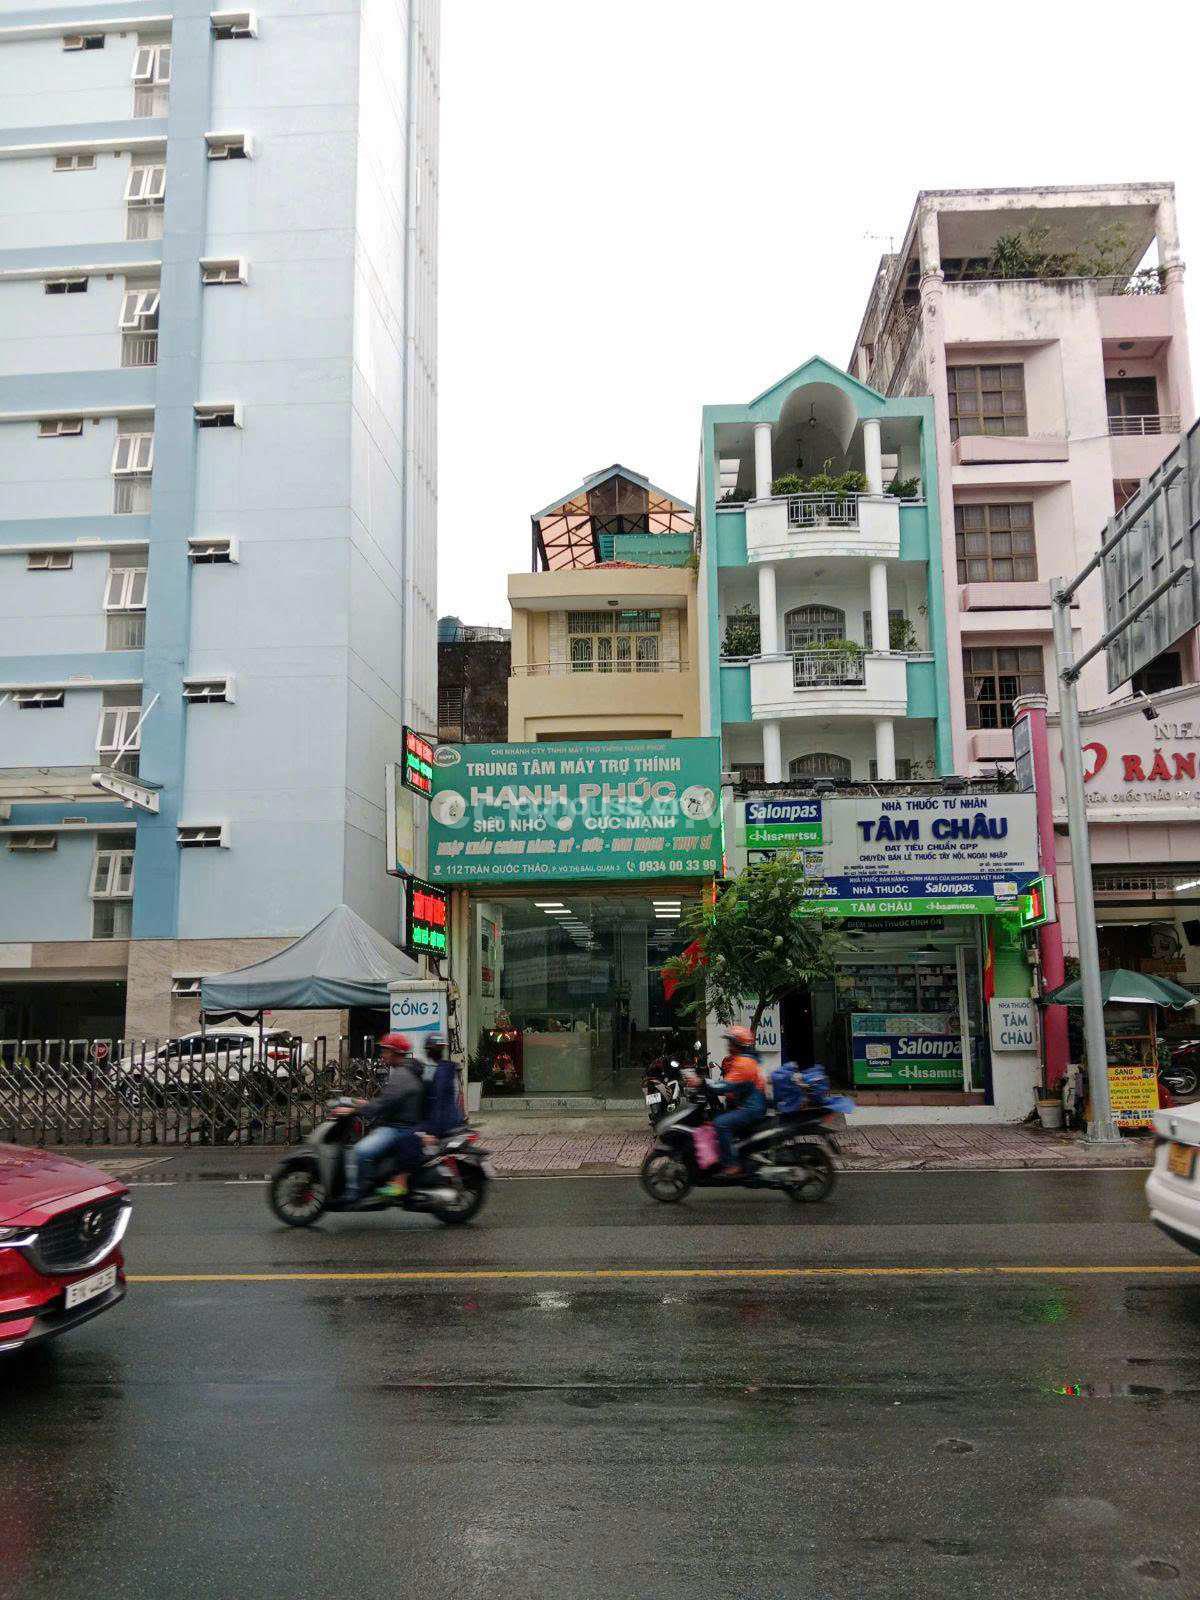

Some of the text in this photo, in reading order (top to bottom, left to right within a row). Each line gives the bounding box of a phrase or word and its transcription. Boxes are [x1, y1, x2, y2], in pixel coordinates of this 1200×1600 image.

[467, 756, 680, 776] TRUNG TÂM MÁY TRỢ THÍNH
[1121, 748, 1199, 781] RĂN
[470, 777, 677, 809] HẠNH PHÚC
[881, 797, 987, 811] NHÀ THUỐC TƯ NHÂN
[473, 814, 675, 833] SIÊU NHỎ CỰC MẠNH
[857, 813, 1008, 841] TÂM CHÂU
[904, 842, 924, 851] TIÊU
[927, 841, 957, 851] CHUẨN
[960, 843, 978, 851] GPP
[669, 860, 683, 871] 00
[685, 860, 700, 871] 33
[702, 859, 717, 870] 99
[859, 853, 886, 862] CHUYÊN
[914, 852, 937, 860] THUỐC
[446, 864, 464, 875] 112
[465, 863, 490, 874] TRẦN
[491, 863, 520, 874] QUỐC
[852, 884, 874, 895] NHÀ
[876, 884, 909, 895] THUỐC
[850, 901, 876, 913] TÂM
[879, 900, 913, 912] CHÂU
[391, 997, 439, 1016] CỔNG 2
[1003, 1011, 1028, 1027] TÂM
[1000, 1029, 1033, 1045] CHÂU
[898, 1037, 964, 1058] Salonpa
[898, 1065, 964, 1078] Hisamits
